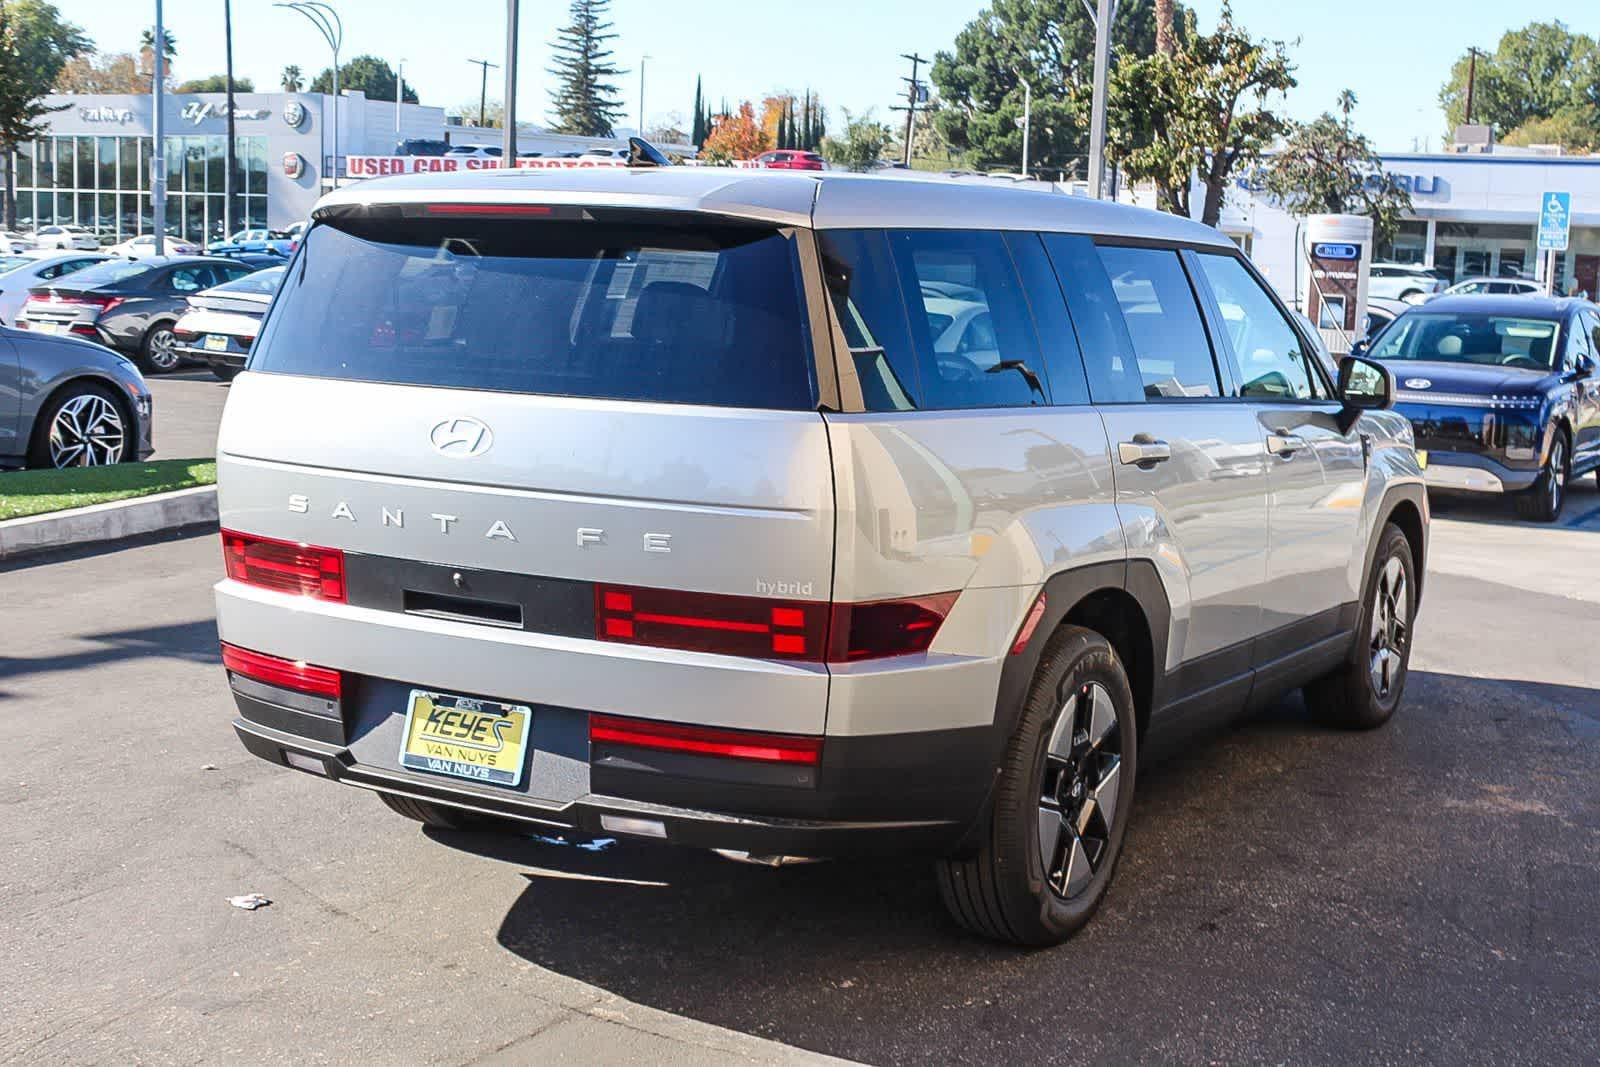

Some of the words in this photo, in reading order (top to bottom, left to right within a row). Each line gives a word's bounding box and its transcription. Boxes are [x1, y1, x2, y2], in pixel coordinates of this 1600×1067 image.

[350, 158, 404, 175] USED
[413, 159, 458, 172] CAR
[287, 493, 519, 543] SANTA
[576, 526, 675, 554] FE
[755, 578, 813, 598] hybrid
[420, 708, 513, 752] KEYES
[426, 744, 453, 757] VAN
[458, 748, 498, 766] NUYS
[426, 758, 452, 772] VAN
[453, 762, 491, 778] NUYS
